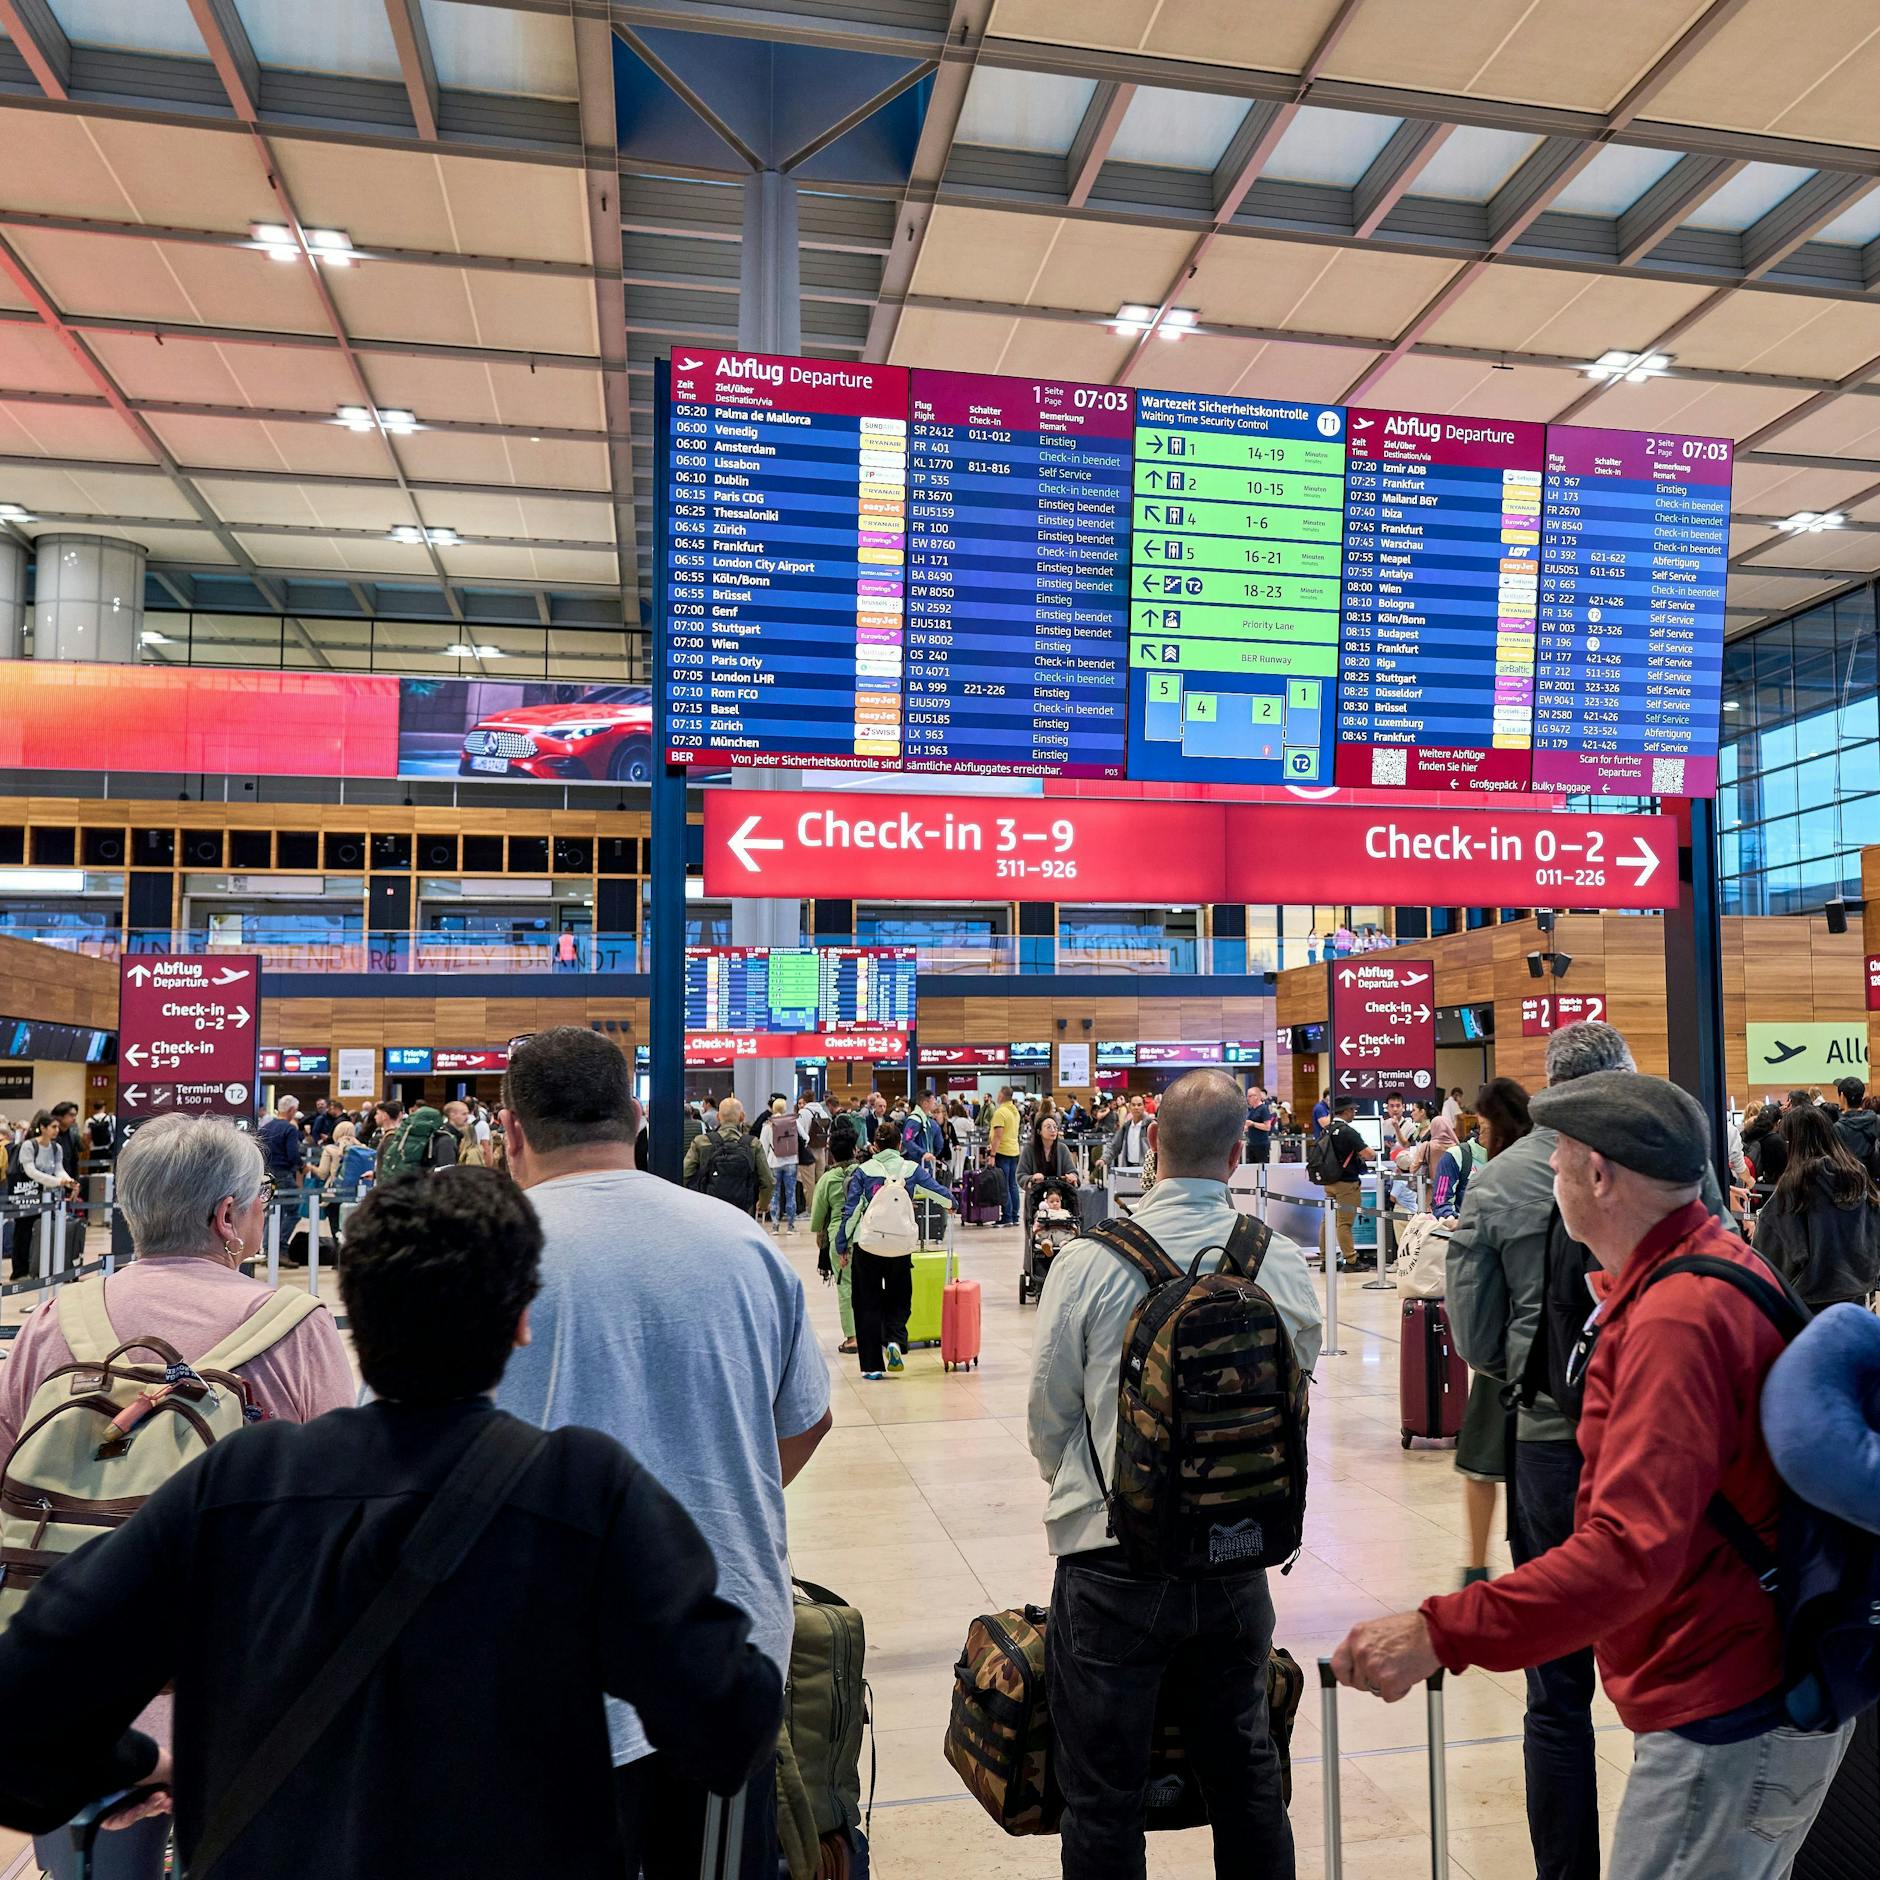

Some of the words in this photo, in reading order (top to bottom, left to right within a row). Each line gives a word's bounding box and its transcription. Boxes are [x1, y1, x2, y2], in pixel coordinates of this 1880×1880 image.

[715, 356, 783, 385] Abflug
[790, 366, 872, 389] Departure
[677, 380, 694, 389] Zeit
[715, 383, 754, 394] Ziel/über
[1044, 386, 1063, 395] Seite
[677, 390, 696, 400] Time
[715, 393, 772, 406] Destination/via
[1032, 385, 1040, 403] 1
[1074, 389, 1127, 410] 07:03
[914, 400, 932, 411] Flug
[1044, 396, 1062, 407] Page
[1141, 395, 1196, 411] Wartezeit
[1198, 400, 1308, 420] Sicherheitskontrolle
[676, 405, 707, 416] 05:20
[715, 407, 748, 420] Palma
[750, 410, 764, 421] de
[766, 411, 811, 425] Mallorca
[914, 411, 934, 421] Flight
[969, 405, 1001, 415] Schalter
[1039, 411, 1084, 424] Bemerkung
[1141, 410, 1174, 424] Waiting
[1176, 413, 1198, 424] Time
[1200, 415, 1235, 429] Security
[1237, 418, 1268, 430] Control
[1321, 417, 1335, 430] T1
[1039, 421, 1066, 431] Remark
[1384, 416, 1440, 442] Abflug
[1445, 424, 1514, 444] Departure
[914, 424, 927, 435] SR
[929, 425, 953, 437] 2412
[968, 429, 1010, 442] 011-012
[1039, 435, 1076, 450] Einstieg
[1351, 438, 1366, 446] Zeit
[1658, 439, 1674, 447] Seite
[1351, 447, 1368, 456] Time
[1383, 440, 1416, 450] Ziel/über
[1645, 438, 1655, 454] 2
[1682, 441, 1727, 460] 07:03
[1189, 443, 1194, 455] 1
[1248, 447, 1284, 461] 14-19
[1383, 450, 1431, 461] Destination/via
[1549, 453, 1564, 463] Flug
[1657, 448, 1672, 457] Page
[1351, 460, 1376, 471] 07:20
[1383, 463, 1406, 473] Izmir
[1406, 465, 1426, 475] ADB
[1548, 463, 1566, 472] Flight
[1594, 457, 1621, 466] Schalter
[1653, 462, 1690, 473] Bemerkung
[675, 471, 706, 483] 06:10
[714, 474, 749, 486] Dublin
[1653, 471, 1676, 479] Remark
[1188, 478, 1196, 490] 2
[1247, 481, 1283, 495] 10-15
[1187, 513, 1196, 525] 4
[1246, 516, 1267, 528] 1-6
[1186, 547, 1194, 559] 5
[1245, 550, 1280, 564] 16-21
[1545, 549, 1556, 558] LO
[1560, 550, 1576, 559] 392
[1590, 552, 1625, 563] 621-622
[1652, 556, 1699, 569] Abfertigung
[674, 570, 704, 582] 06:55
[712, 573, 769, 586] Köln/Bonn
[1244, 584, 1281, 598] 18-23
[1242, 620, 1273, 631] Priority
[1275, 622, 1294, 630] Lane
[1241, 654, 1257, 662] BER
[1259, 655, 1291, 665] Runway
[1344, 656, 1369, 666] 08:20
[1376, 657, 1395, 669] Riga
[1499, 664, 1529, 673] airBaltic
[672, 702, 702, 713] 07:15
[710, 703, 739, 714] Basel
[672, 718, 702, 729] 07:15
[710, 720, 743, 730] Zürich
[1536, 738, 1548, 747] LH
[1552, 739, 1567, 748] 179
[1582, 740, 1617, 750] 421-426
[1643, 742, 1659, 751] Self
[1660, 743, 1688, 752] Service
[671, 751, 693, 761] BER
[730, 753, 751, 764] Von
[752, 753, 779, 766] jeder
[781, 754, 878, 768] Sicherheitskontrolle
[881, 758, 902, 769] sind
[1418, 748, 1451, 758] Weitere
[1452, 749, 1485, 761] Abflüge
[1579, 754, 1598, 763] Scan
[1599, 754, 1612, 764] for
[1613, 755, 1642, 765] further
[906, 760, 952, 771] sämtliche
[953, 761, 1011, 775] Abfluggates
[1013, 764, 1062, 775] erreichbar.
[1418, 760, 1445, 771] finden
[1447, 761, 1459, 771] Sie
[1460, 762, 1478, 772] hier
[1598, 767, 1641, 778] Departures
[1531, 781, 1555, 793] Bulky
[1556, 782, 1591, 794] Baggage
[798, 810, 981, 850] Check-in
[996, 819, 1074, 852] 3–9
[1366, 824, 1521, 860] Check-in
[1535, 830, 1604, 862] 0–2
[997, 860, 1077, 878] 311–926
[1536, 869, 1605, 886] 011–226
[153, 962, 202, 978] Abflug
[1358, 966, 1394, 980] Abflug
[154, 976, 208, 989] Departure
[1358, 978, 1399, 990] Departure
[162, 1003, 224, 1016] Check-in
[1366, 1002, 1411, 1012] Check-in
[1540, 998, 1550, 1028] 2
[1586, 998, 1604, 1023] 2
[195, 1018, 224, 1030] 0–2
[1390, 1014, 1412, 1024] 0–2
[692, 1038, 735, 1049] Check-in
[825, 1038, 866, 1048] Check-in
[1359, 1034, 1405, 1045] Check-in
[152, 1041, 214, 1054] Check-in
[1359, 1046, 1380, 1057] 3–9
[1826, 1038, 1868, 1064] All
[151, 1056, 180, 1068] 3–9
[1378, 1070, 1412, 1079] Terminal
[176, 1084, 223, 1094] Terminal
[229, 1089, 244, 1099] T2
